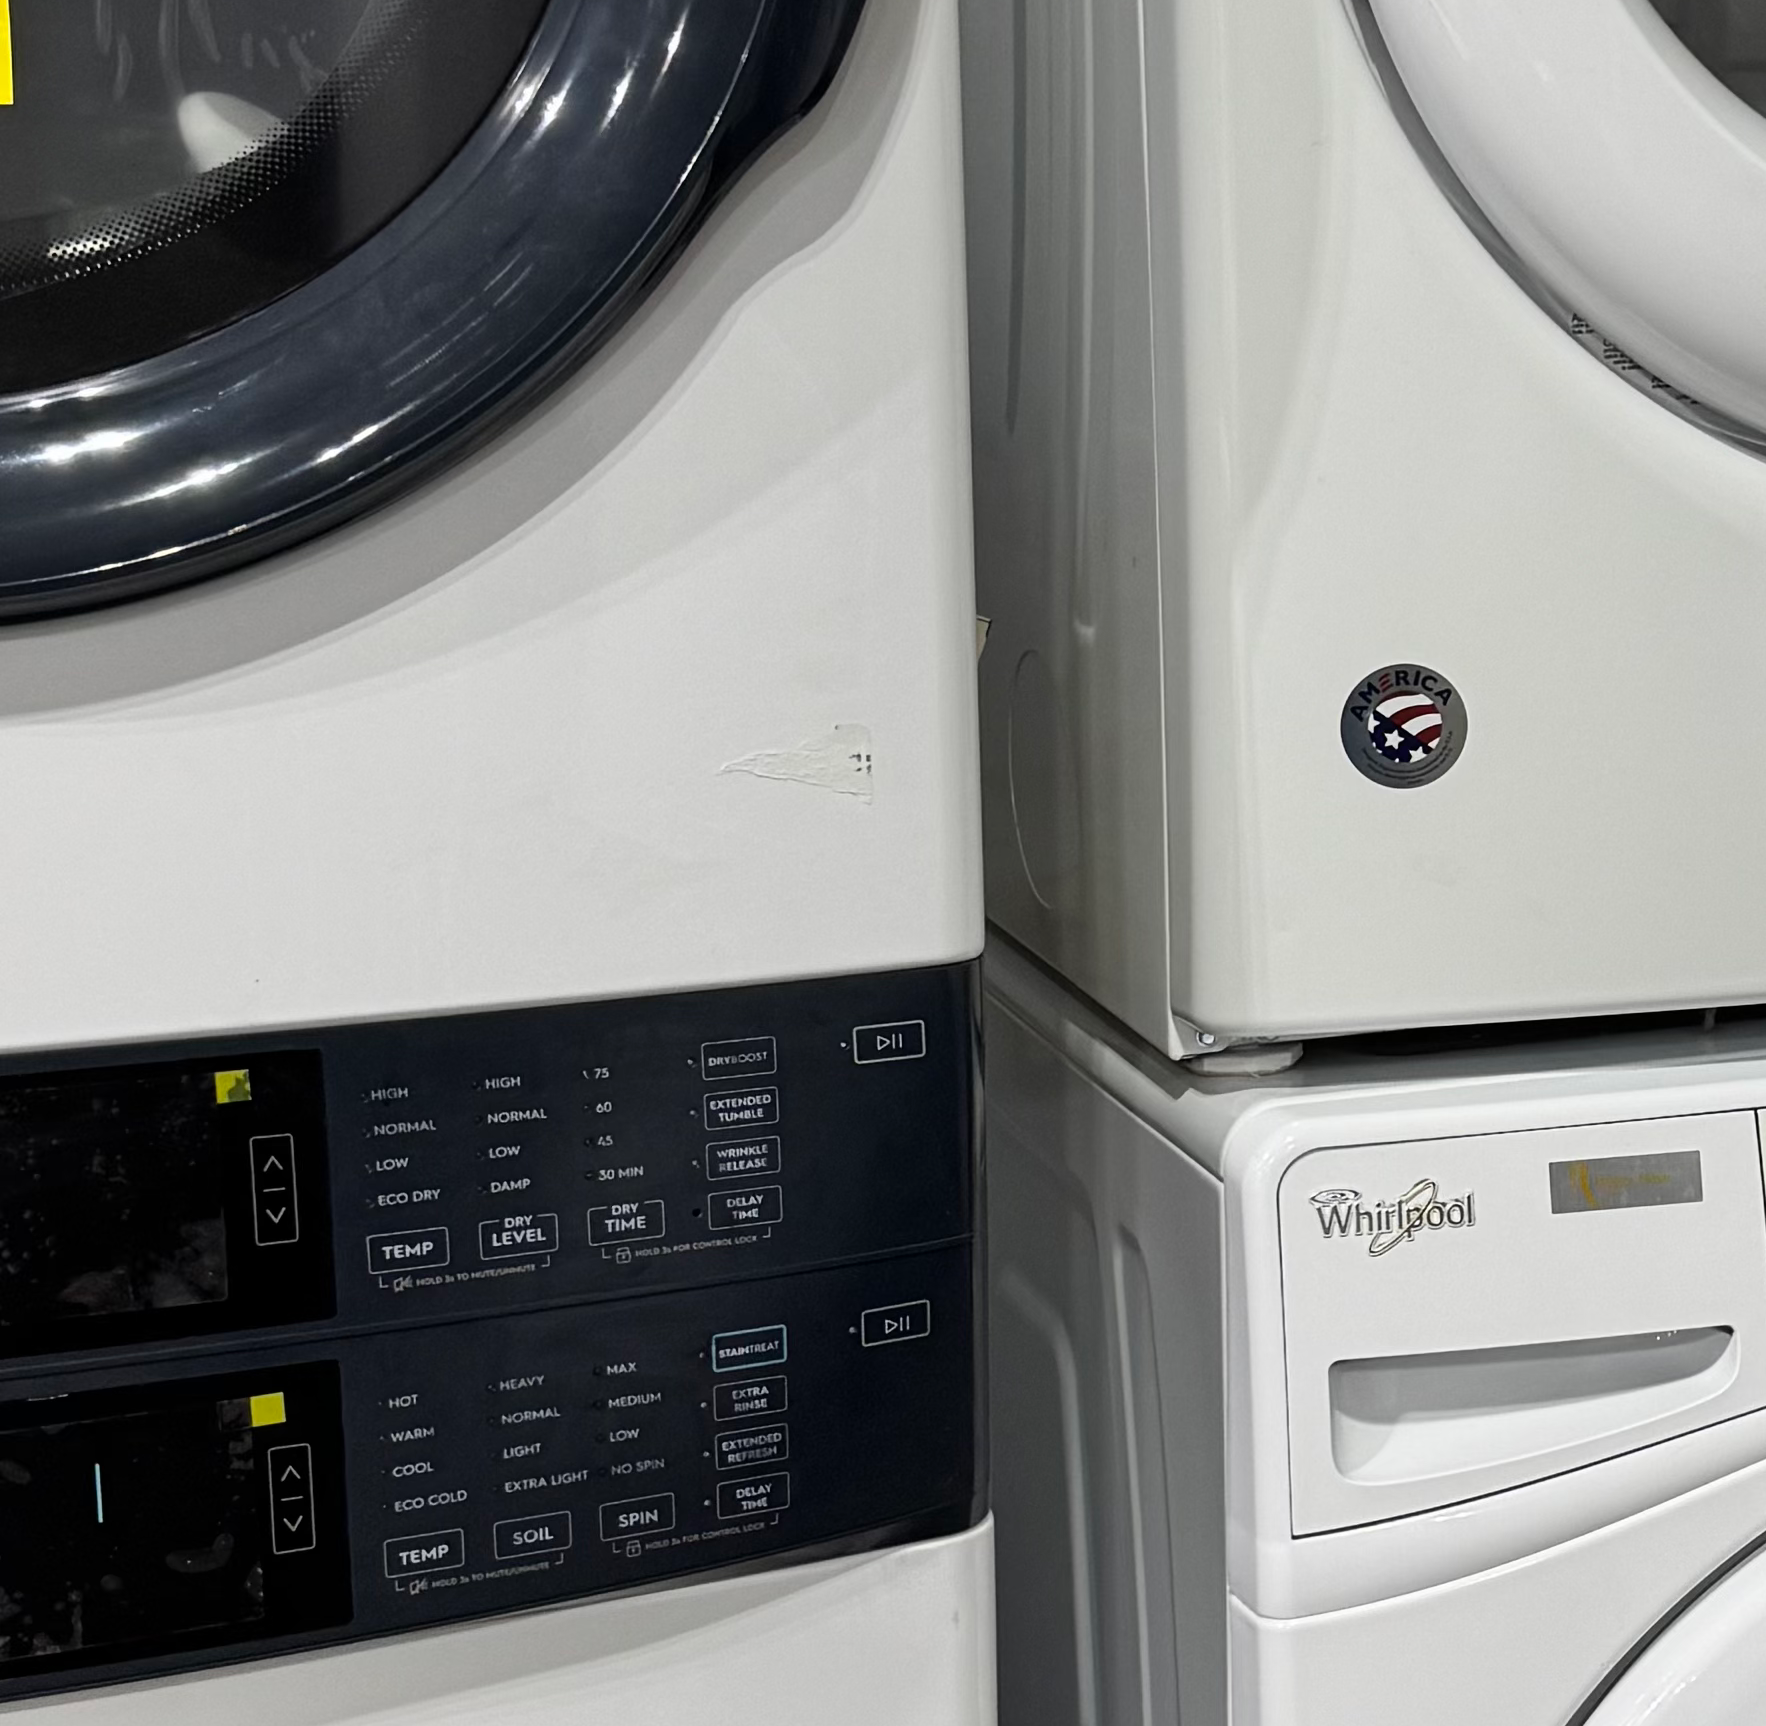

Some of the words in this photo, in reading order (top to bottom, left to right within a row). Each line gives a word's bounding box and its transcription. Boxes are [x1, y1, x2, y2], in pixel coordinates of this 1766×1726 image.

[1350, 670, 1452, 722] AMERICA
[707, 1050, 768, 1067] DRYBOOST
[594, 1068, 609, 1079] 75
[485, 1077, 521, 1089] HIGH
[371, 1088, 408, 1100] HIGH
[596, 1102, 612, 1113] 60
[710, 1095, 771, 1110] EXTENDED
[488, 1109, 547, 1124] NORMAL
[719, 1108, 764, 1122] TUMBLE
[374, 1120, 436, 1136] NORMAL
[598, 1135, 613, 1146] 45
[489, 1146, 521, 1159] LOW
[717, 1144, 768, 1158] WRINKLE
[376, 1158, 408, 1171] LOW
[719, 1158, 767, 1172] RELEASE
[599, 1169, 614, 1181] 30
[619, 1166, 644, 1179] MIN
[491, 1179, 531, 1193] DAMP
[378, 1193, 408, 1206] ECO
[413, 1189, 440, 1203] DRY
[727, 1195, 763, 1207] DELAY
[611, 1203, 638, 1216] DRY
[732, 1209, 759, 1220] TIME
[1313, 1183, 1475, 1248] Whirlpool
[504, 1216, 532, 1228] DRY
[605, 1216, 646, 1233] TIME
[492, 1228, 546, 1246] LEVEL
[382, 1242, 434, 1259] TEMP
[719, 1340, 779, 1358] STAINTREAT
[607, 1362, 637, 1375] MAX
[500, 1375, 545, 1391] HEAVY
[608, 1393, 661, 1408] MEDIUM
[732, 1386, 769, 1400] EXTRA
[389, 1394, 418, 1408] HOT
[734, 1398, 767, 1412] RINSE
[502, 1407, 560, 1424] NORMAL
[391, 1427, 435, 1442] WARM
[610, 1429, 640, 1442] LOW
[722, 1433, 782, 1451] EXTENDED
[503, 1443, 541, 1459] LIGHT
[728, 1446, 777, 1463] REFRESH
[392, 1462, 434, 1477] COOL
[611, 1463, 632, 1475] NO
[636, 1459, 665, 1472] SPIN
[505, 1477, 547, 1493] EXTRA
[551, 1470, 589, 1486] LIGHT
[736, 1483, 772, 1499] DELAY
[394, 1497, 424, 1512] ECO
[428, 1489, 468, 1506] COLD
[741, 1497, 768, 1510] TIME
[619, 1510, 658, 1527] SPIN
[513, 1527, 554, 1545] SOIL
[399, 1545, 449, 1565] TEMP
